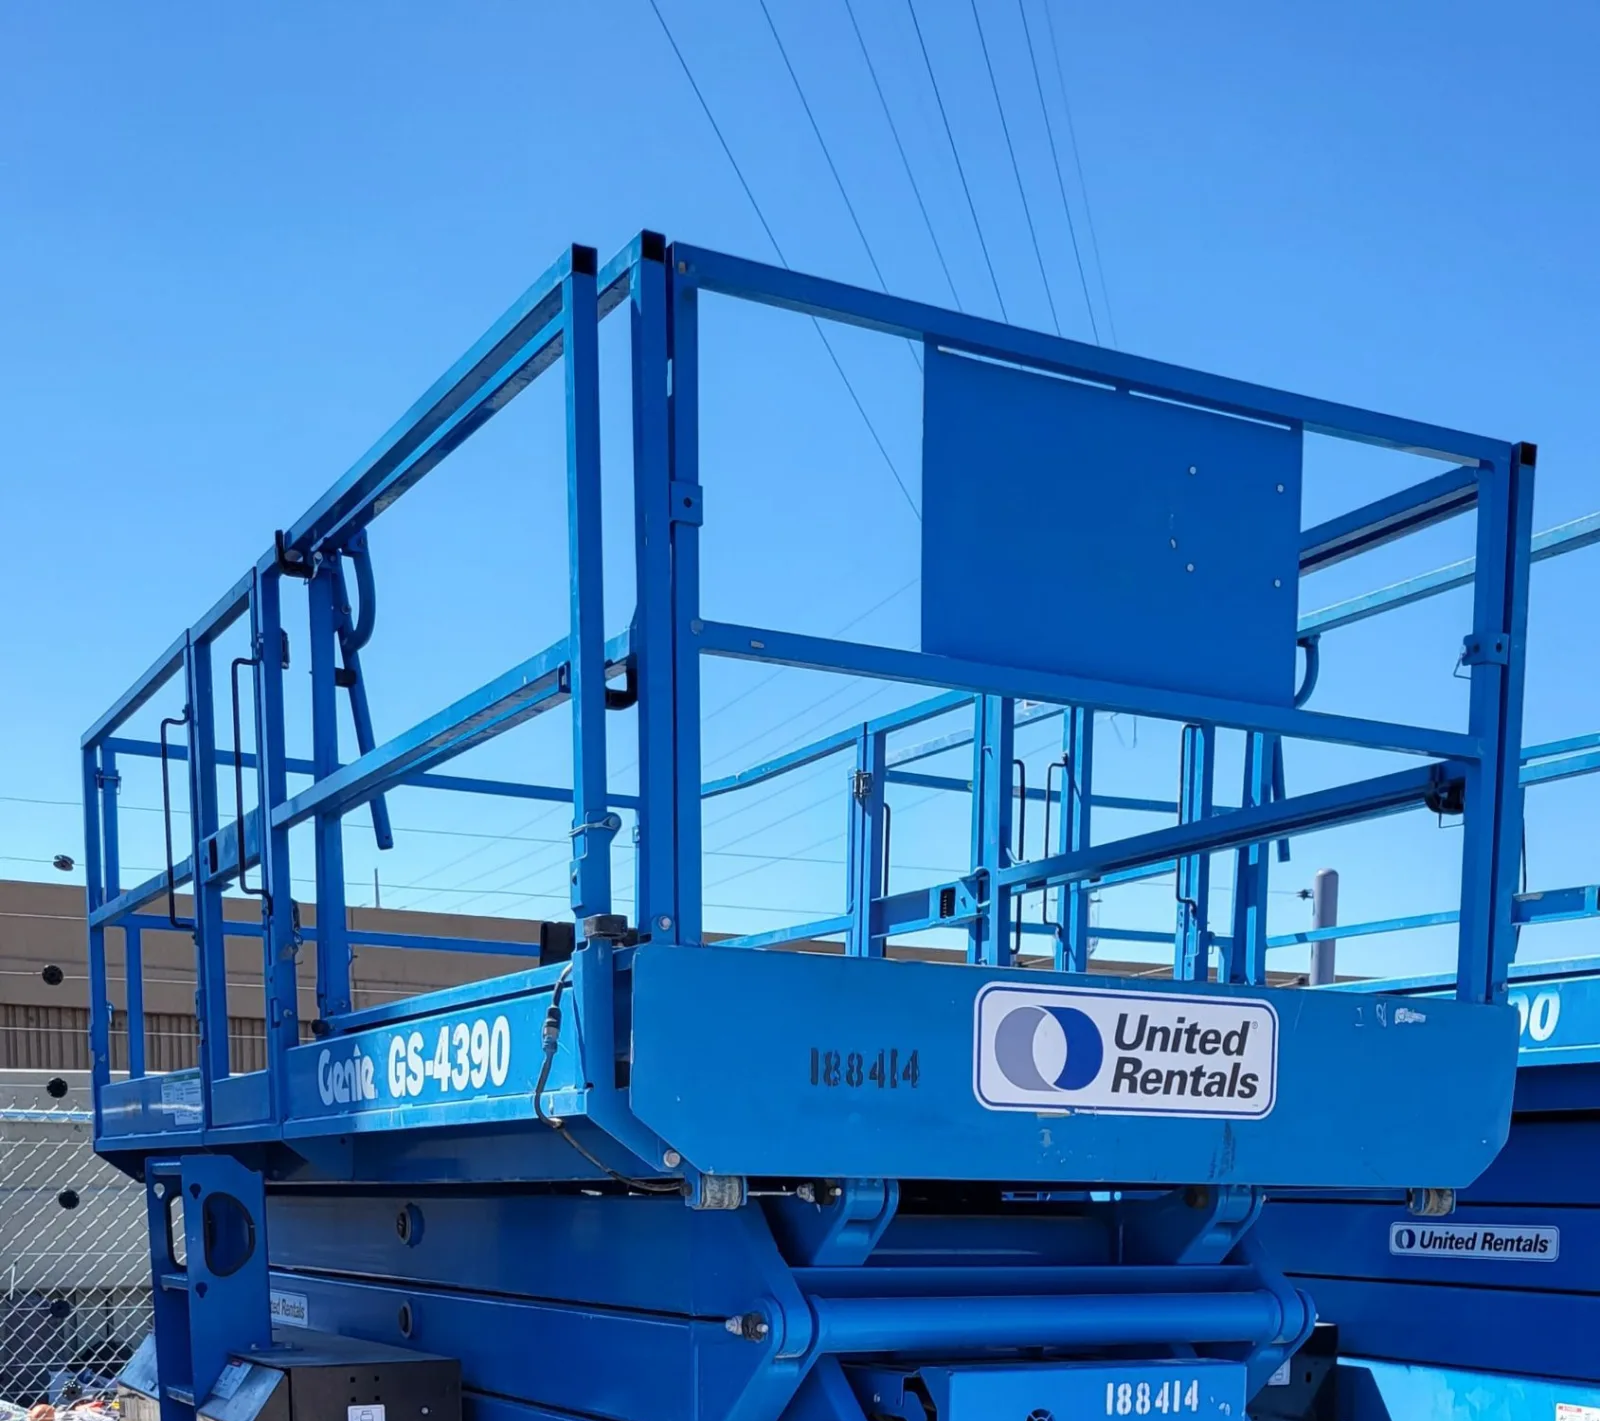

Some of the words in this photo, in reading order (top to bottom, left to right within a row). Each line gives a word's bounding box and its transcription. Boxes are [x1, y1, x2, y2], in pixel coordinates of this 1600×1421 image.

[1114, 1013, 1250, 1056] United
[318, 1044, 374, 1106] Genie
[388, 1015, 510, 1098] GS-4390
[810, 1047, 919, 1089] 188414
[1111, 1056, 1259, 1099] Rentals
[1420, 1230, 1477, 1251] United
[1481, 1232, 1549, 1253] Rentals
[1106, 1379, 1198, 1415] 188414
